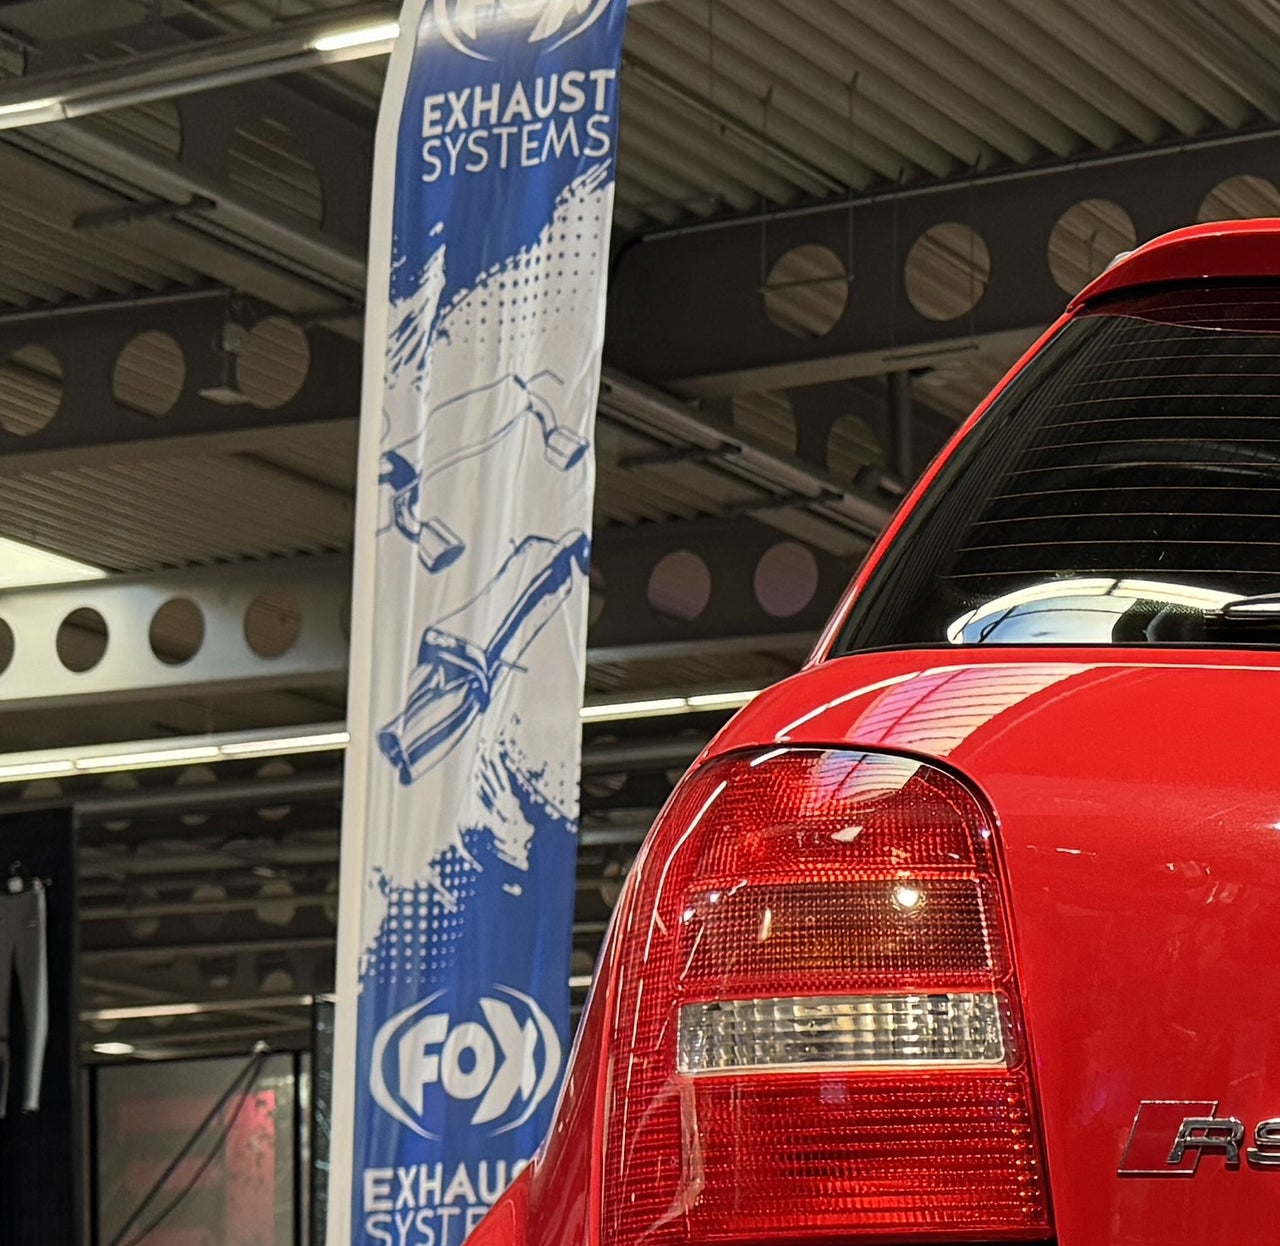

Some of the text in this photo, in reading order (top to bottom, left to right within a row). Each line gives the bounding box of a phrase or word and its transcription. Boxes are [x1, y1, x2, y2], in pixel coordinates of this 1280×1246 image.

[422, 69, 616, 138] EXHAUST
[422, 114, 610, 182] SYSTEMS
[398, 997, 538, 1125] FOX
